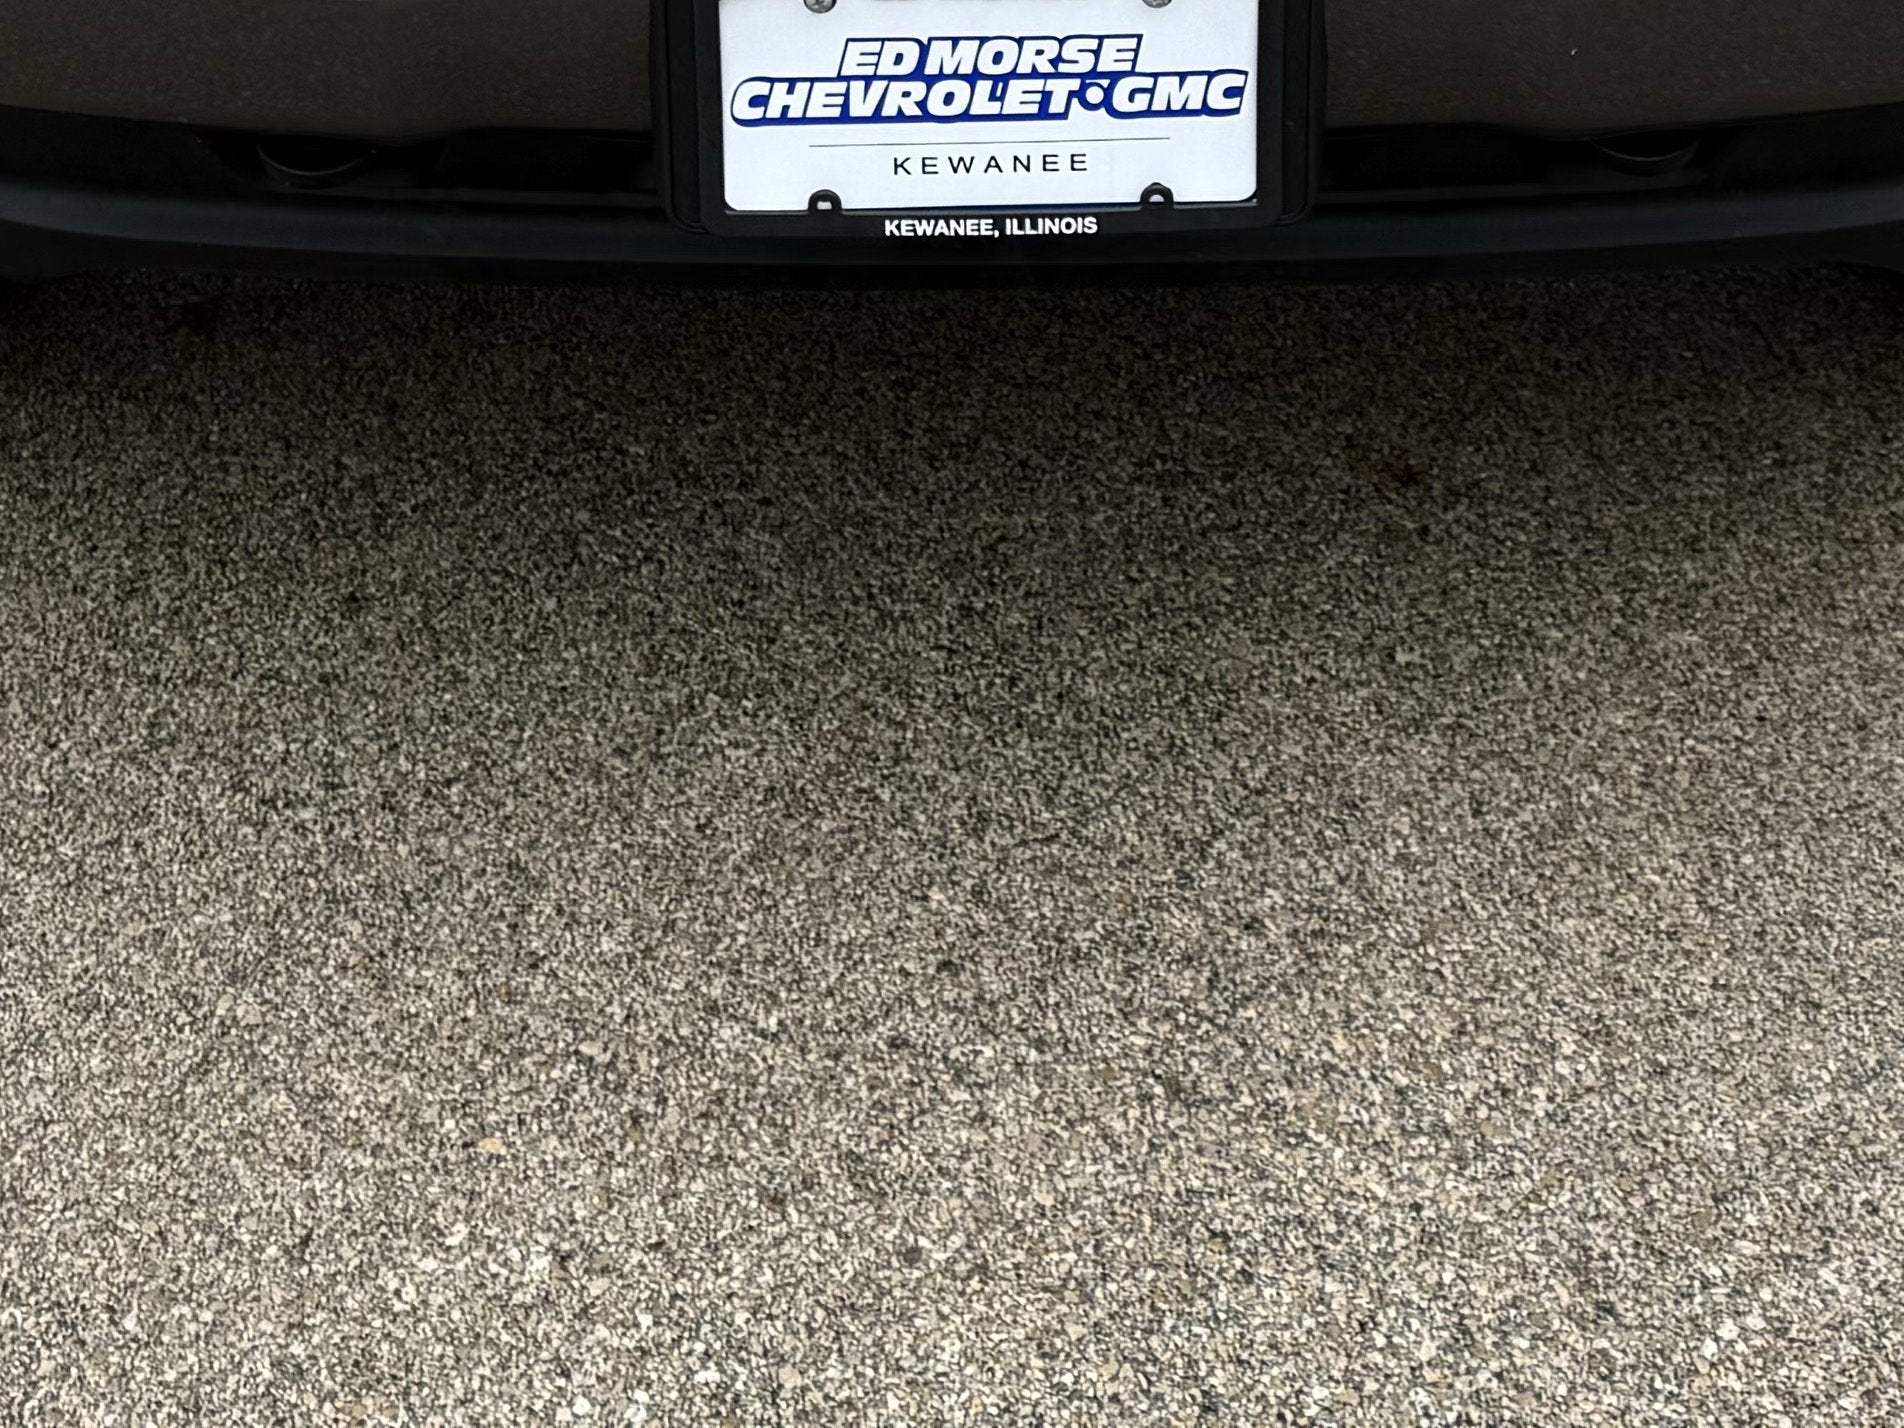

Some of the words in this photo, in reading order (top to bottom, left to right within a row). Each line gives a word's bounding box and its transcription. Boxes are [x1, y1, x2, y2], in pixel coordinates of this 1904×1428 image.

[840, 40, 920, 76] ED
[923, 34, 1138, 74] MORSE
[893, 153, 1088, 175] KEWANEE
[884, 218, 1000, 238] KEWANEE,
[1005, 216, 1098, 236] ILLINOIS
